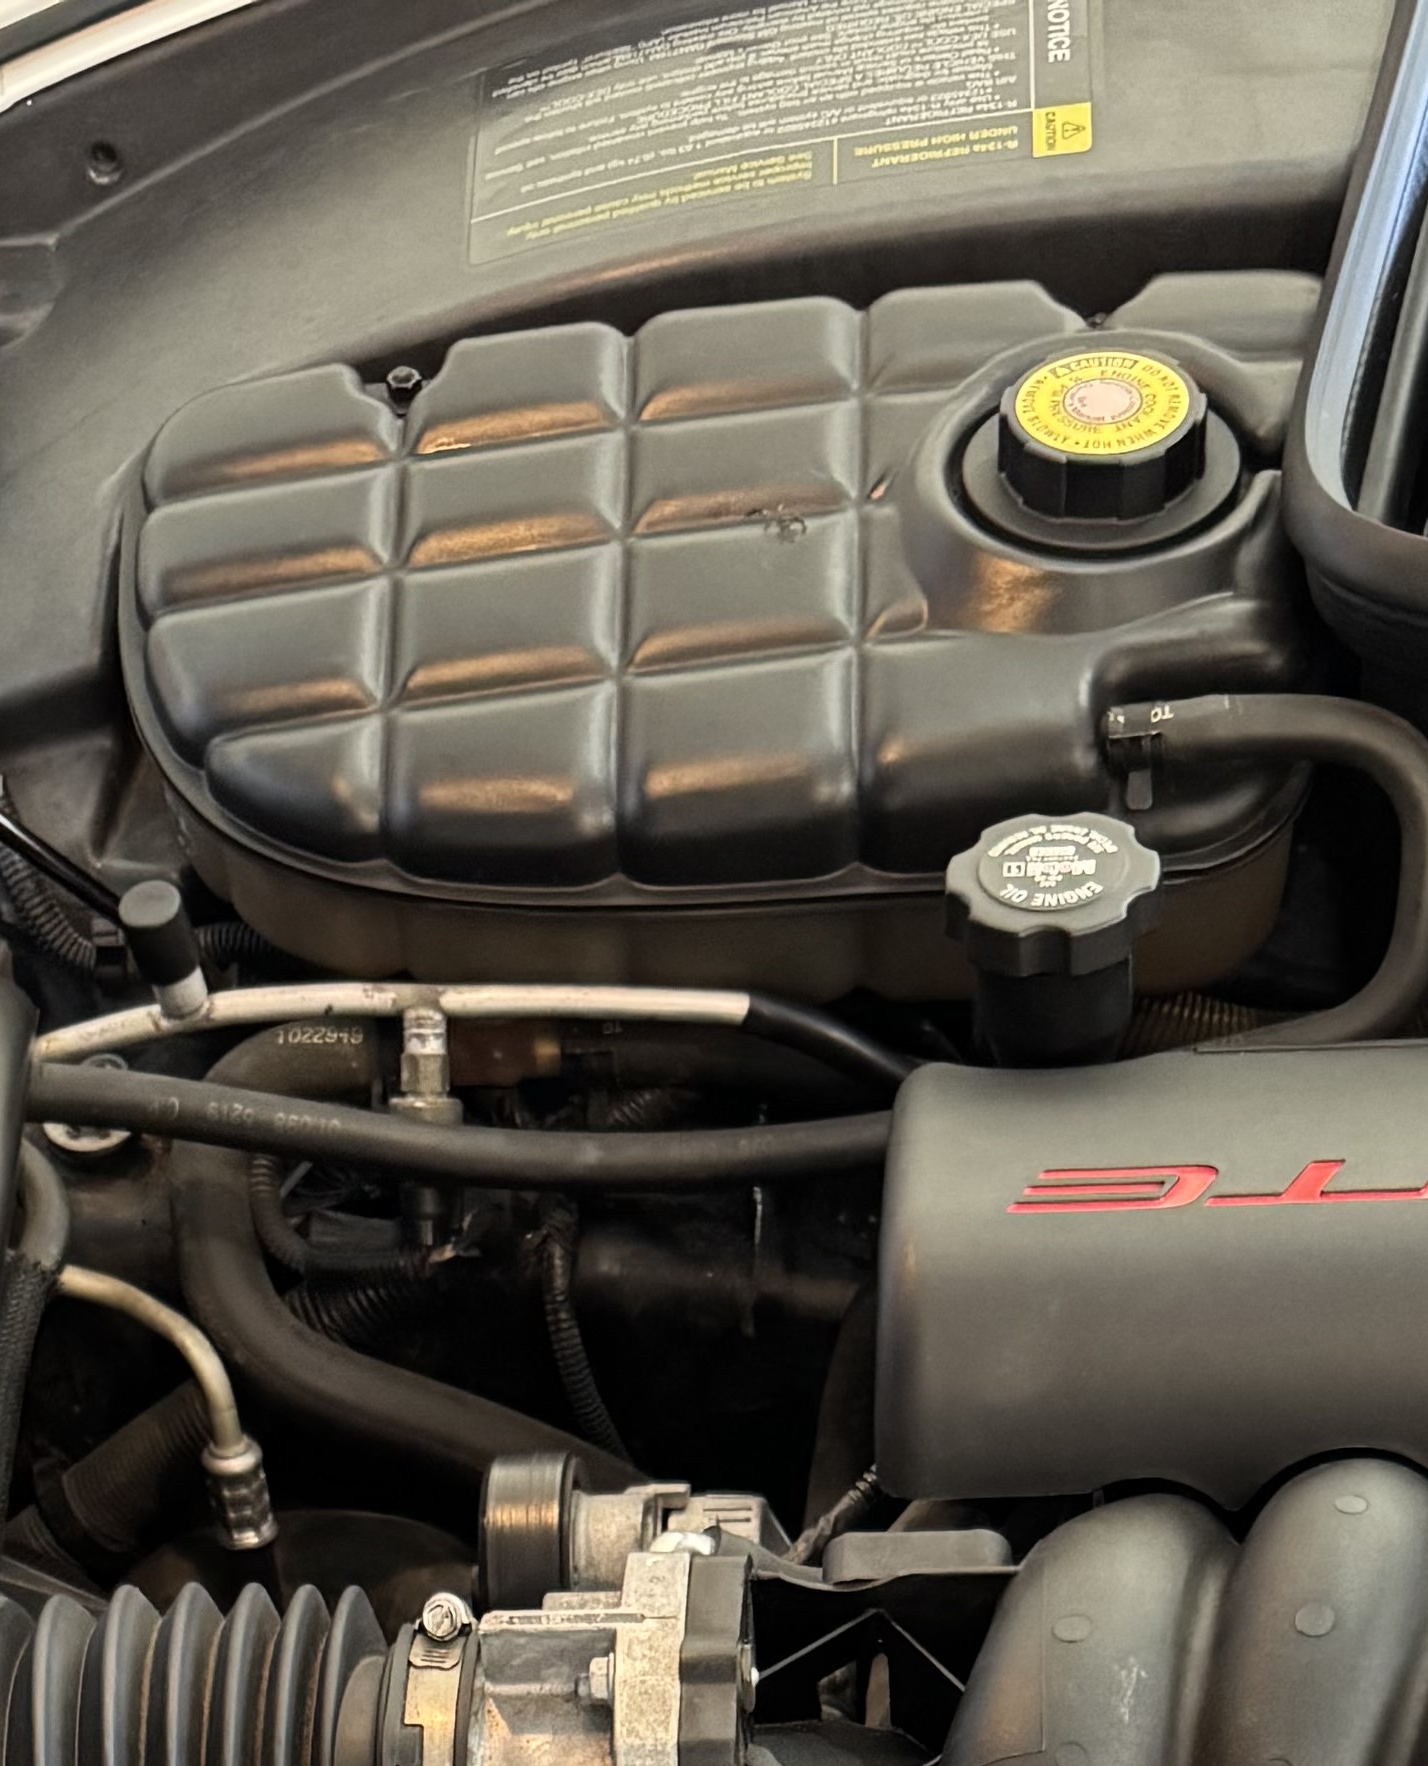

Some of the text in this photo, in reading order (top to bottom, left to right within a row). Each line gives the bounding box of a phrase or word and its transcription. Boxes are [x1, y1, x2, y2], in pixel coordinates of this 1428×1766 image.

[1045, 111, 1056, 151] CAUTION
[872, 143, 970, 167] REFRIGERANT
[1069, 358, 1135, 371] CAUTION
[1084, 440, 1111, 449] HOT
[1000, 882, 1104, 906] ENGINE OIL
